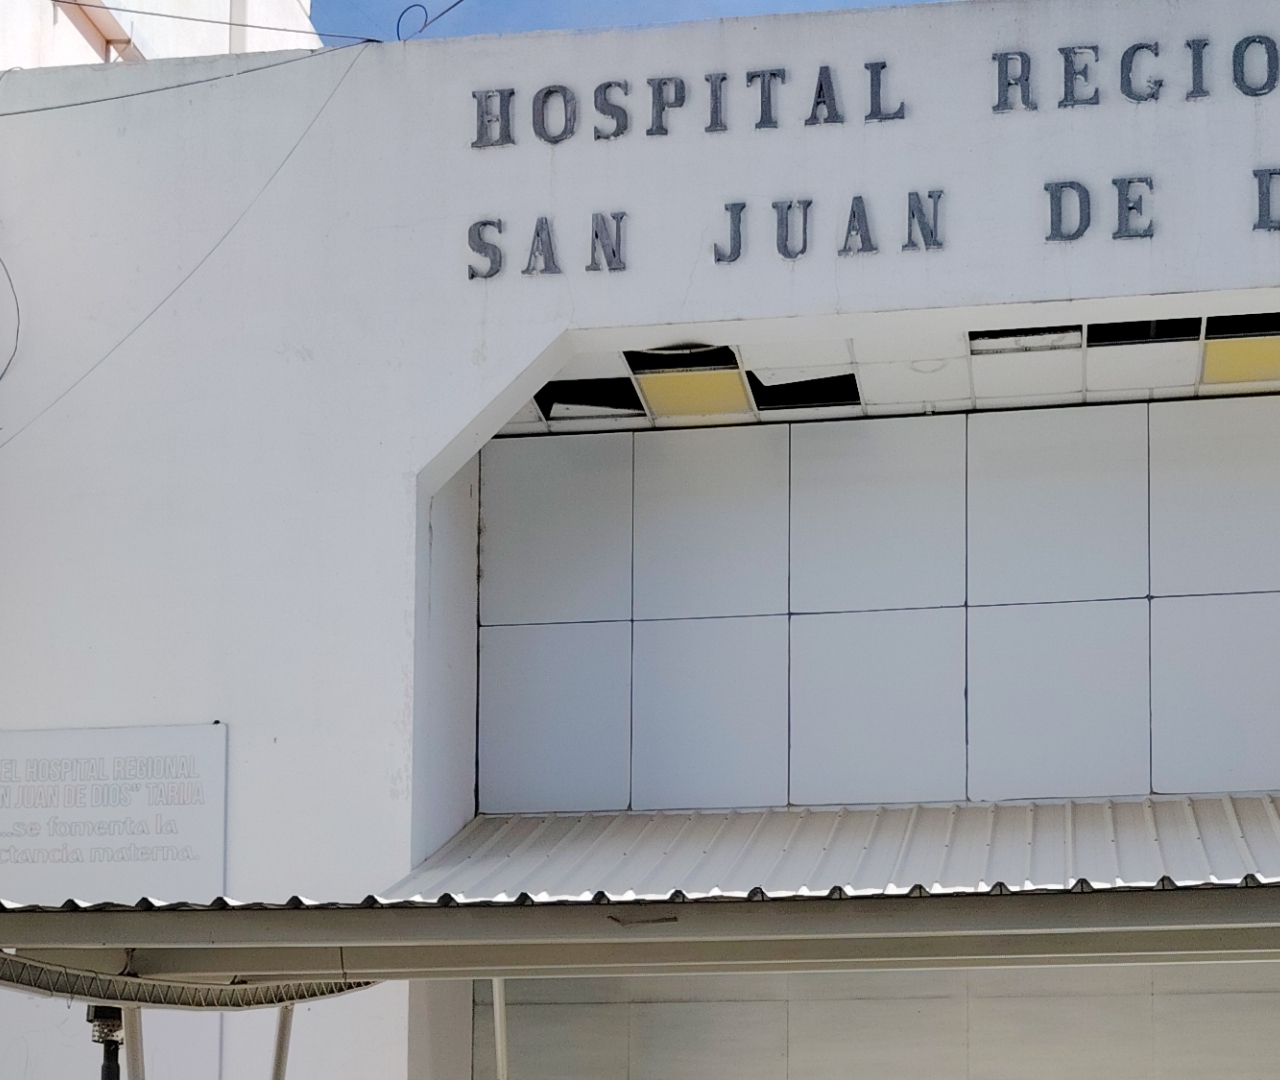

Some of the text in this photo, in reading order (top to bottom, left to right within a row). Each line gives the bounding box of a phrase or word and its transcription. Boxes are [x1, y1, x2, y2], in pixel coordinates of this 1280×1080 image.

[470, 60, 907, 150] HOSPITAL
[466, 210, 629, 280] SAN
[713, 189, 945, 263] JUAN
[1044, 174, 1156, 242] DE
[1, 759, 21, 782] EL
[25, 757, 109, 782] HOSPITAL
[113, 755, 200, 781] REGIONAL
[14, 785, 60, 808] JUAN
[63, 784, 87, 808] DE
[146, 782, 204, 806] TARIJA
[47, 816, 150, 837] fomenta
[155, 814, 179, 835] la
[90, 843, 200, 862] materna.
